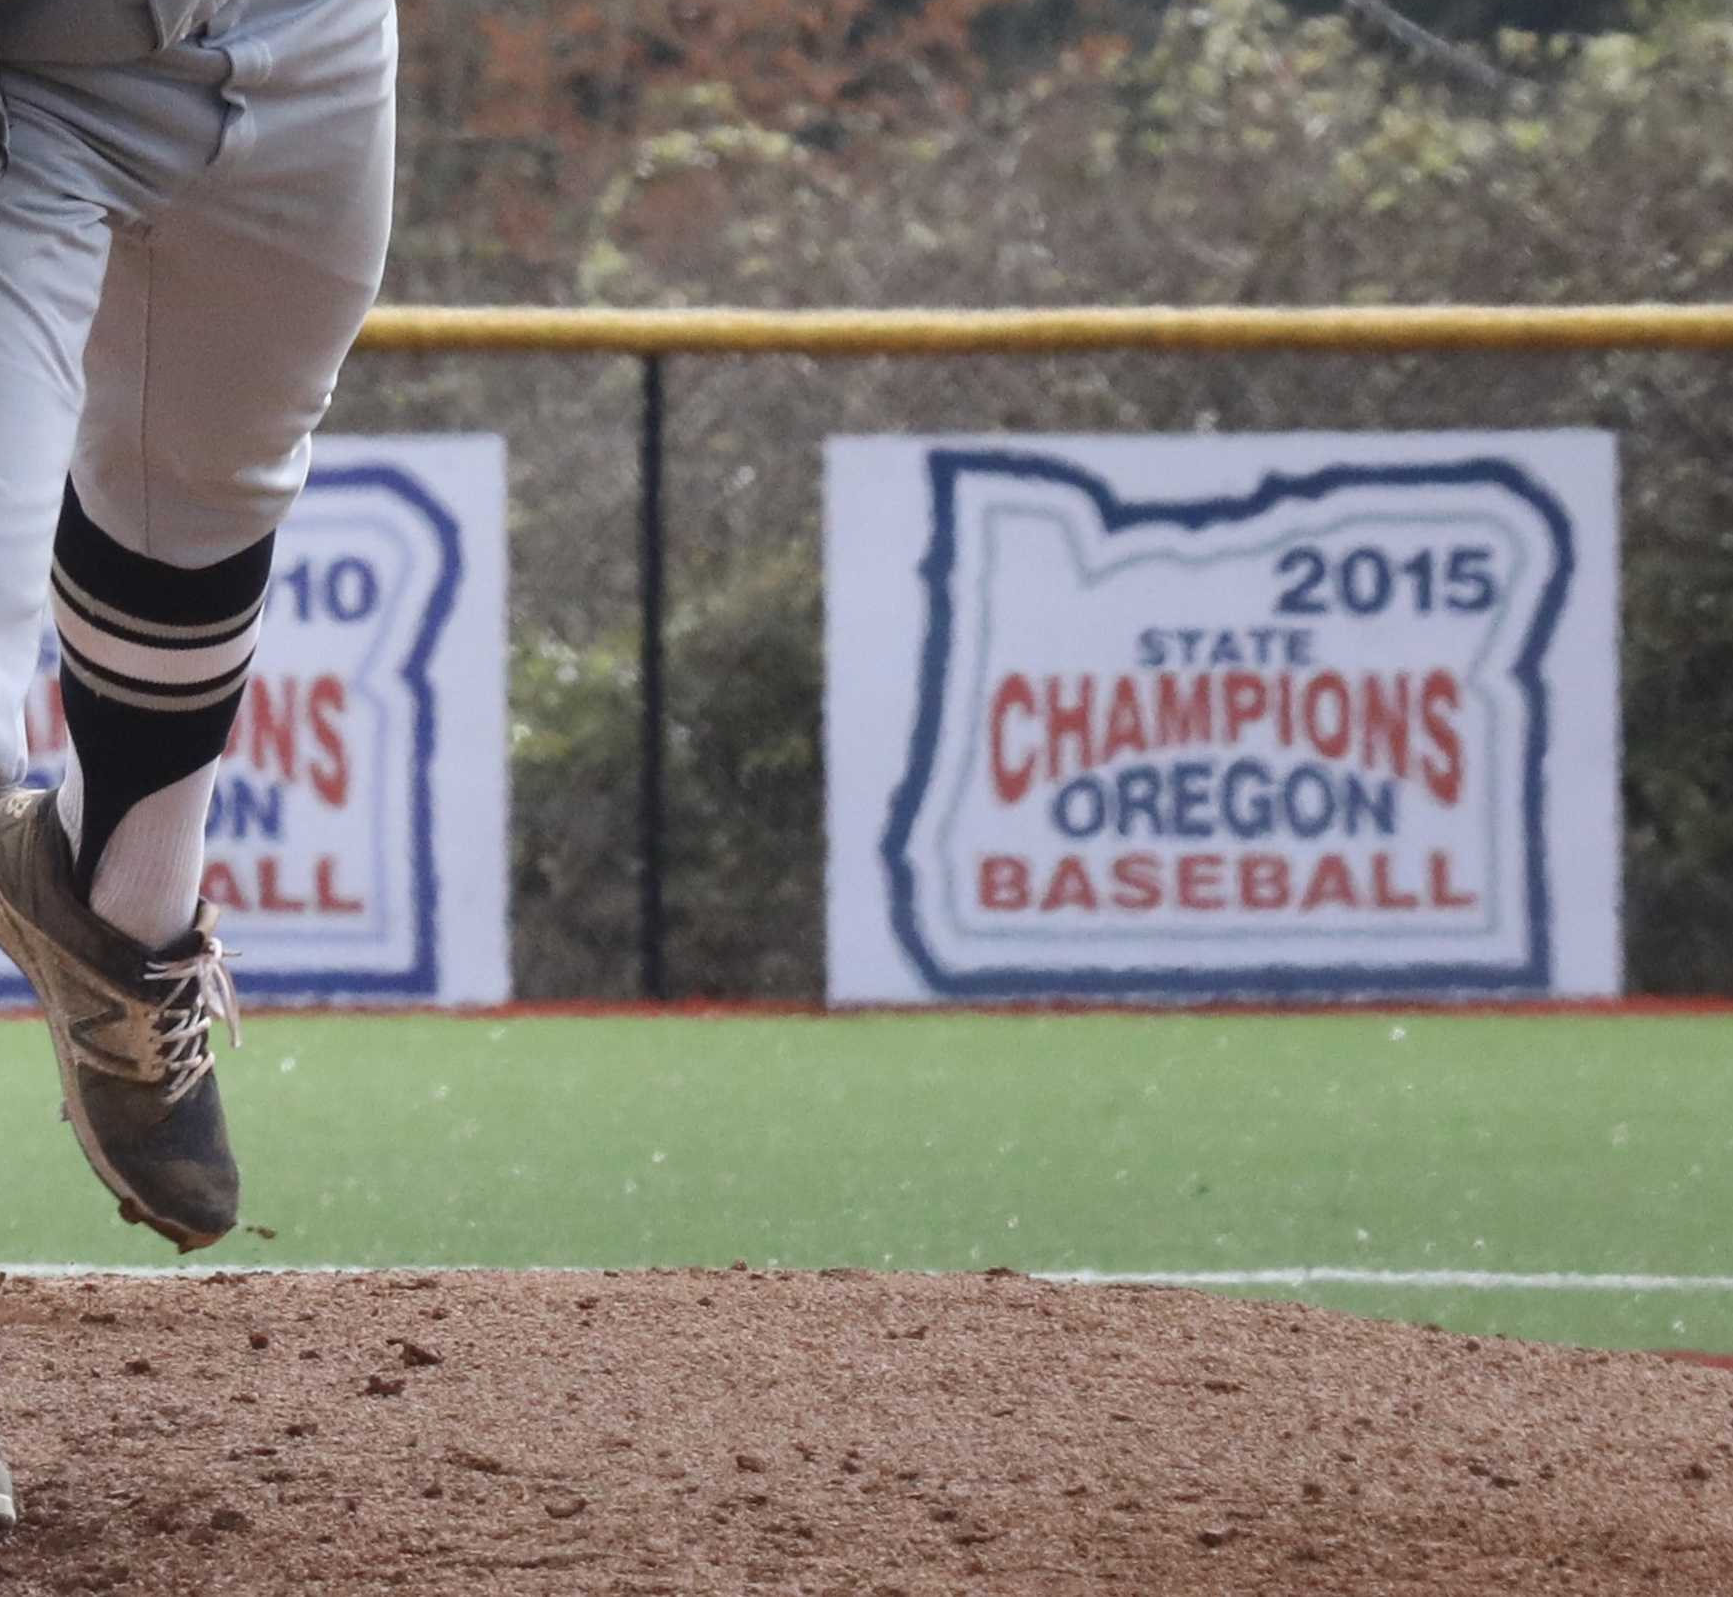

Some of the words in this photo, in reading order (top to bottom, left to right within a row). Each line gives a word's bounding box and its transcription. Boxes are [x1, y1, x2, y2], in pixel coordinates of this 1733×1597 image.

[265, 556, 379, 624] 10
[1273, 545, 1495, 616] 2015
[1138, 626, 1315, 668] STATE
[988, 669, 1465, 804] CHAMPIONS
[1050, 759, 1396, 838] OREGON
[977, 852, 1476, 912] BASEBALL
